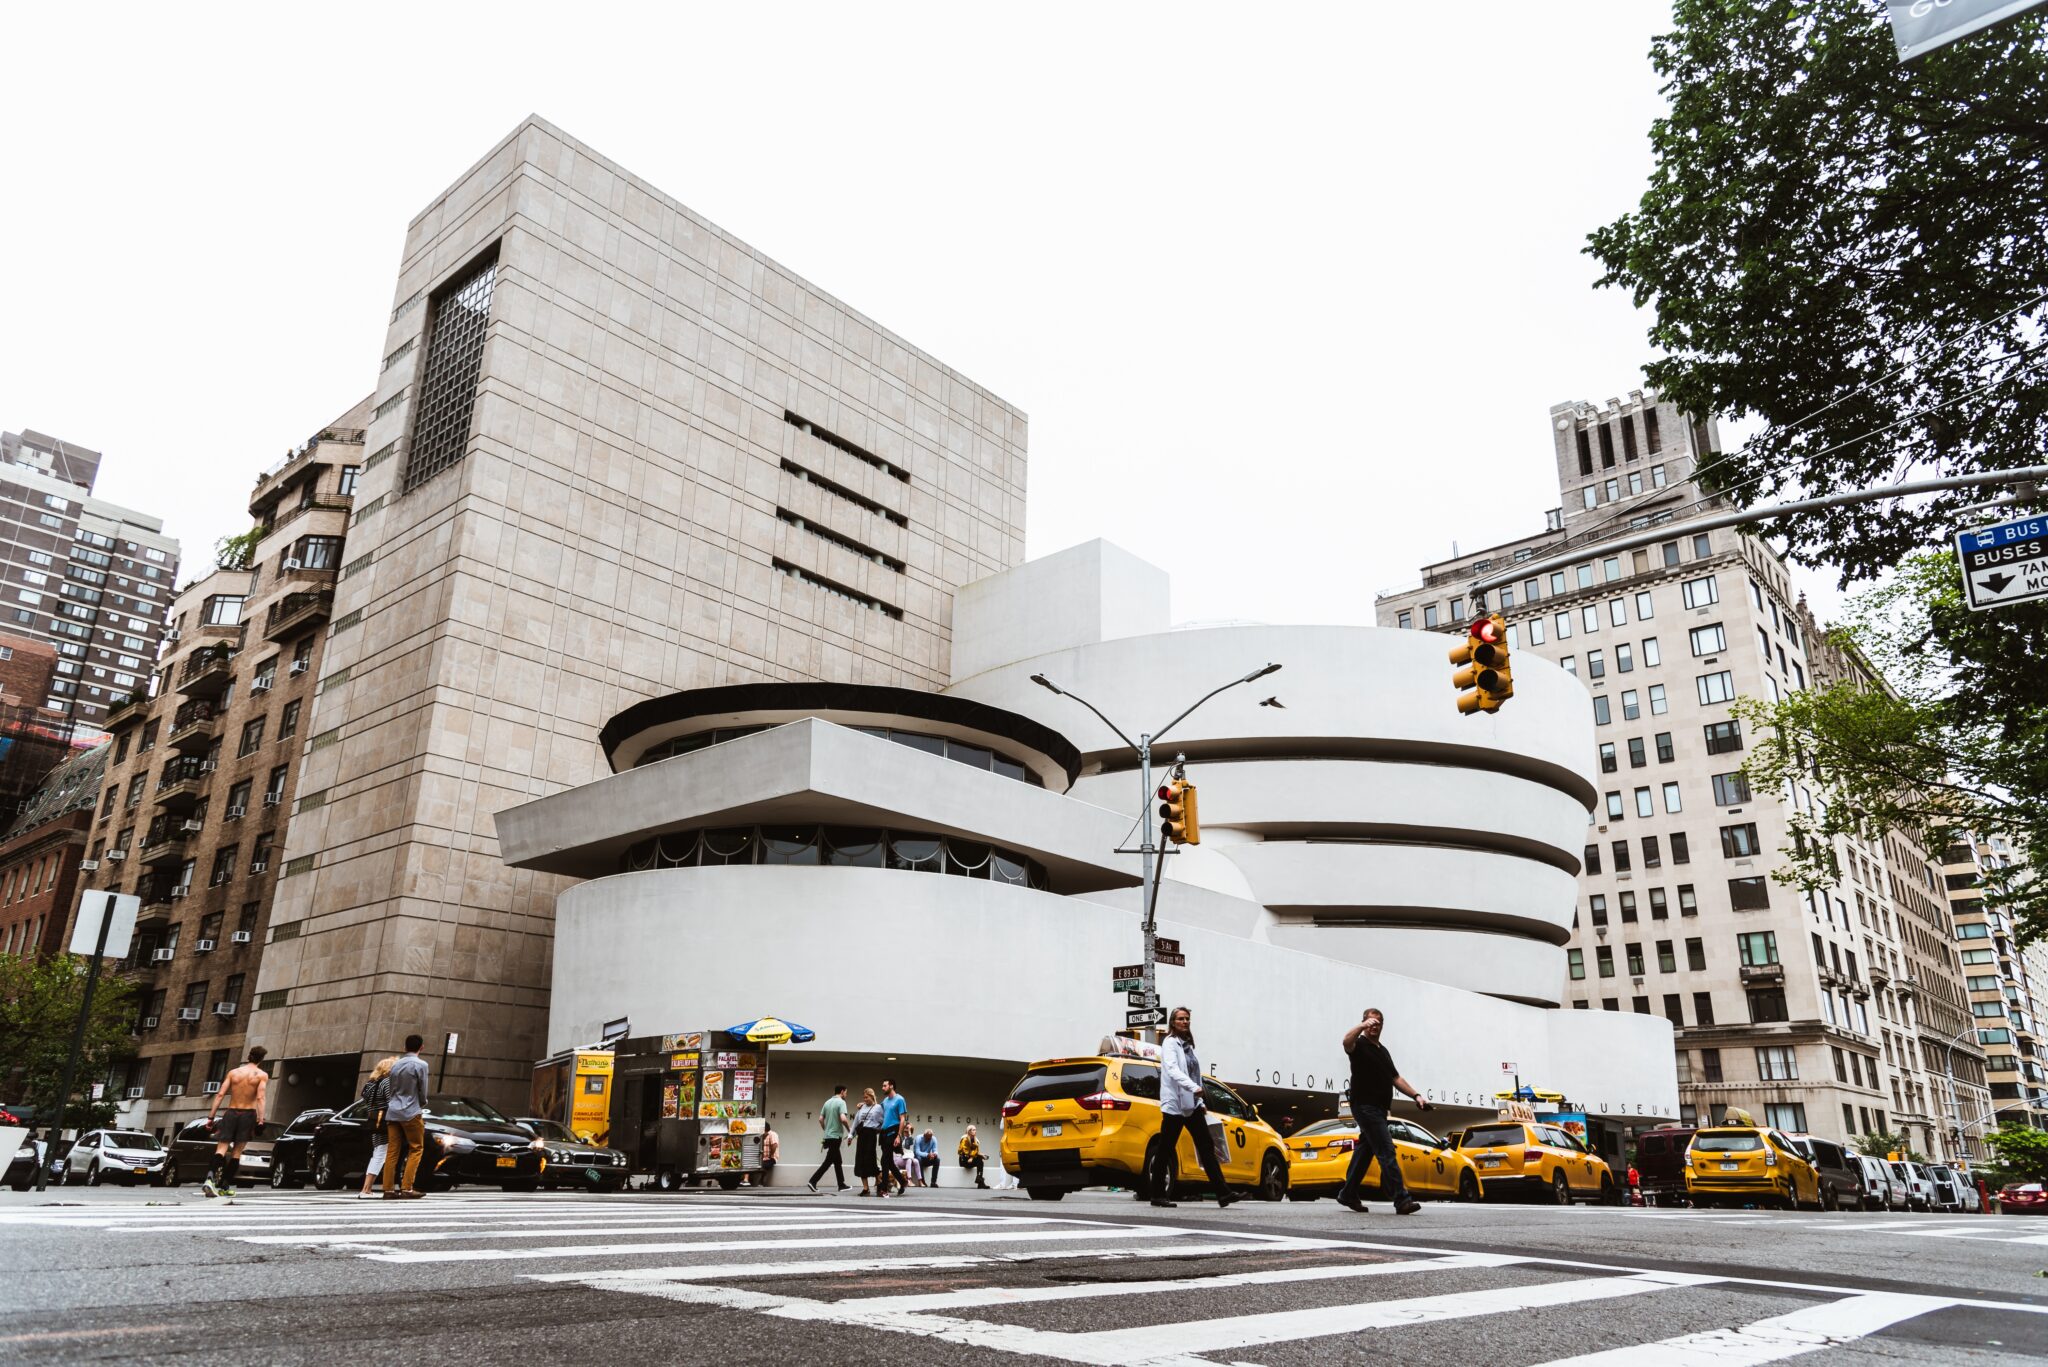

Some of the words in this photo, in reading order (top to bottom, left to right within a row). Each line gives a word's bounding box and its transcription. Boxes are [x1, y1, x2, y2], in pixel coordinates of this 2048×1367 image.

[2005, 522, 2040, 540] BUS
[1974, 541, 2041, 566] BUSES
[1118, 969, 1122, 979] E
[1123, 968, 1131, 978] 89
[1131, 1014, 1143, 1023] ONE
[1147, 1012, 1159, 1021] WAY
[1256, 1068, 1351, 1091] SOLOMO
[1427, 1088, 1537, 1111] GUGGENM
[1574, 1102, 1670, 1116] MUSEUM
